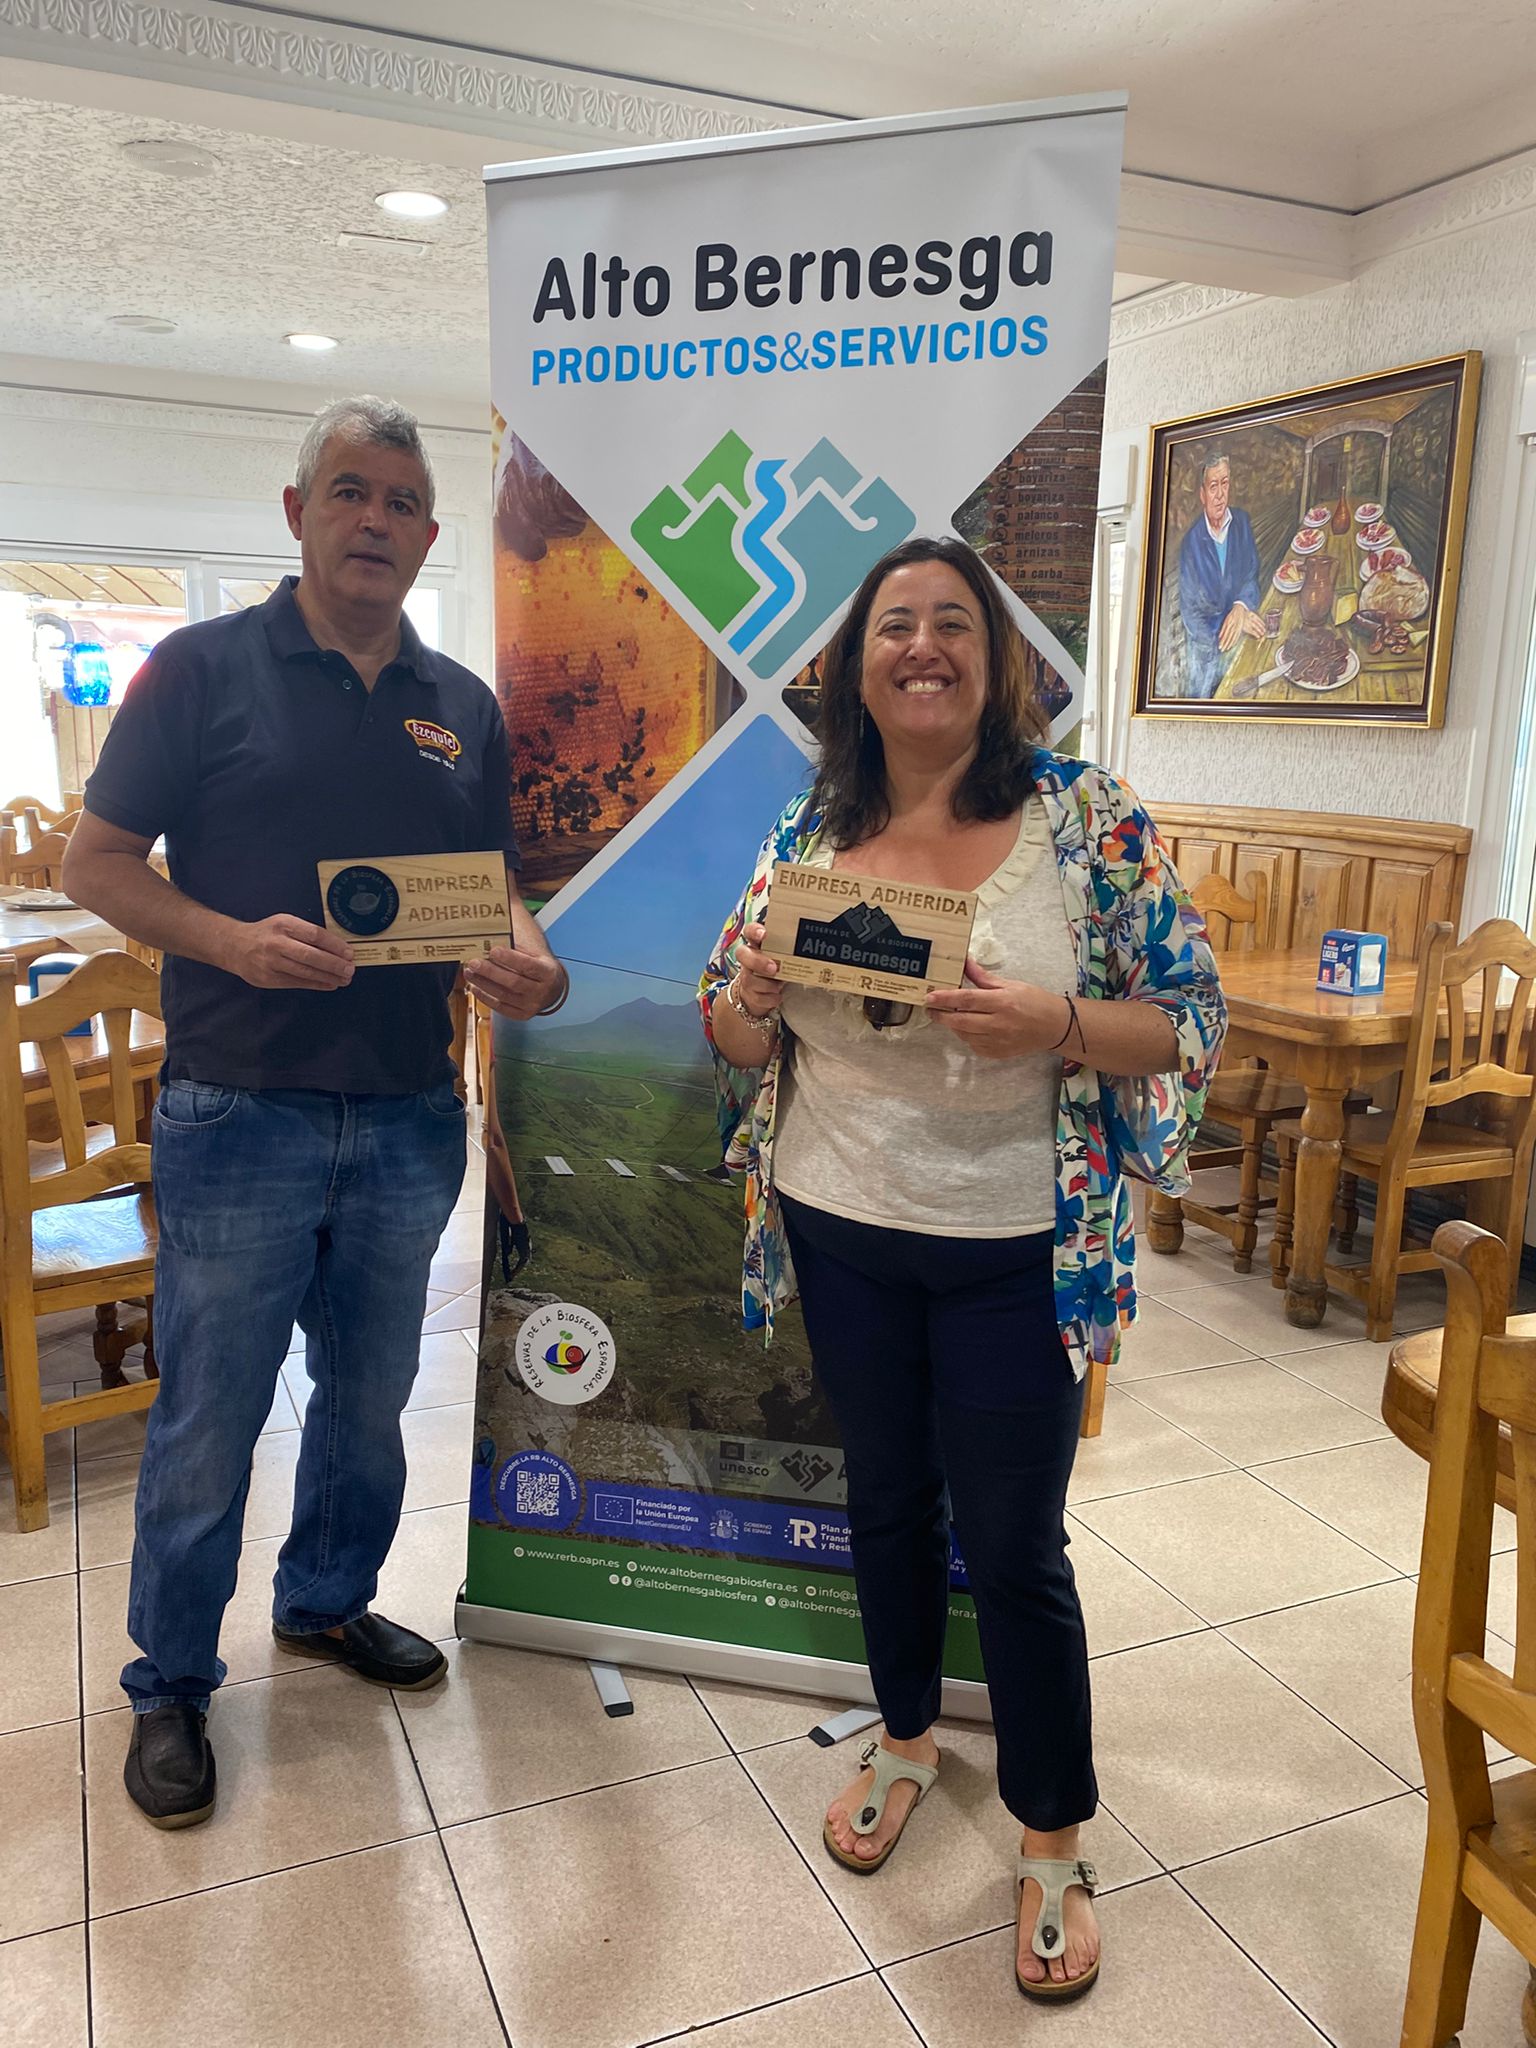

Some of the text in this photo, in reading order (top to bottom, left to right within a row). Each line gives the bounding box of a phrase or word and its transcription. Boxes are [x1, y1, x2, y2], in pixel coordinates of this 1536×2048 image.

[532, 230, 1054, 323] Alto Bernesga
[532, 315, 1049, 386] PRODUCTOS&SERVICIOS
[1016, 546, 1060, 558] arnizas
[1016, 568, 1026, 579] la
[1031, 568, 1063, 579] carba
[412, 722, 456, 751] Ezequiel
[405, 874, 493, 893] EMPRESA
[779, 869, 968, 916] EMPRESA ADHERIDA
[408, 903, 506, 922] ADHERIDA
[805, 925, 838, 936] RESERVA
[802, 938, 836, 957] Alto
[840, 944, 920, 974] Bernesga
[523, 1310, 609, 1392] RESERVAS DE LA BIOSFERA ESPAÑOLAS
[500, 1459, 521, 1490] DESCUBRE
[541, 1456, 559, 1467] ALTO
[720, 1462, 769, 1477] unesco
[636, 1499, 691, 1513] Financiado por
[636, 1508, 699, 1523] la Unión Europea
[821, 1524, 840, 1534] Plan
[821, 1533, 850, 1543] Transf
[828, 1542, 852, 1553] Resil
[527, 1550, 620, 1568] www.rerb.oapn.es
[639, 1563, 798, 1593] www.altobernesgabiosfera.es
[634, 1577, 758, 1603] @altobernesgabiosfera
